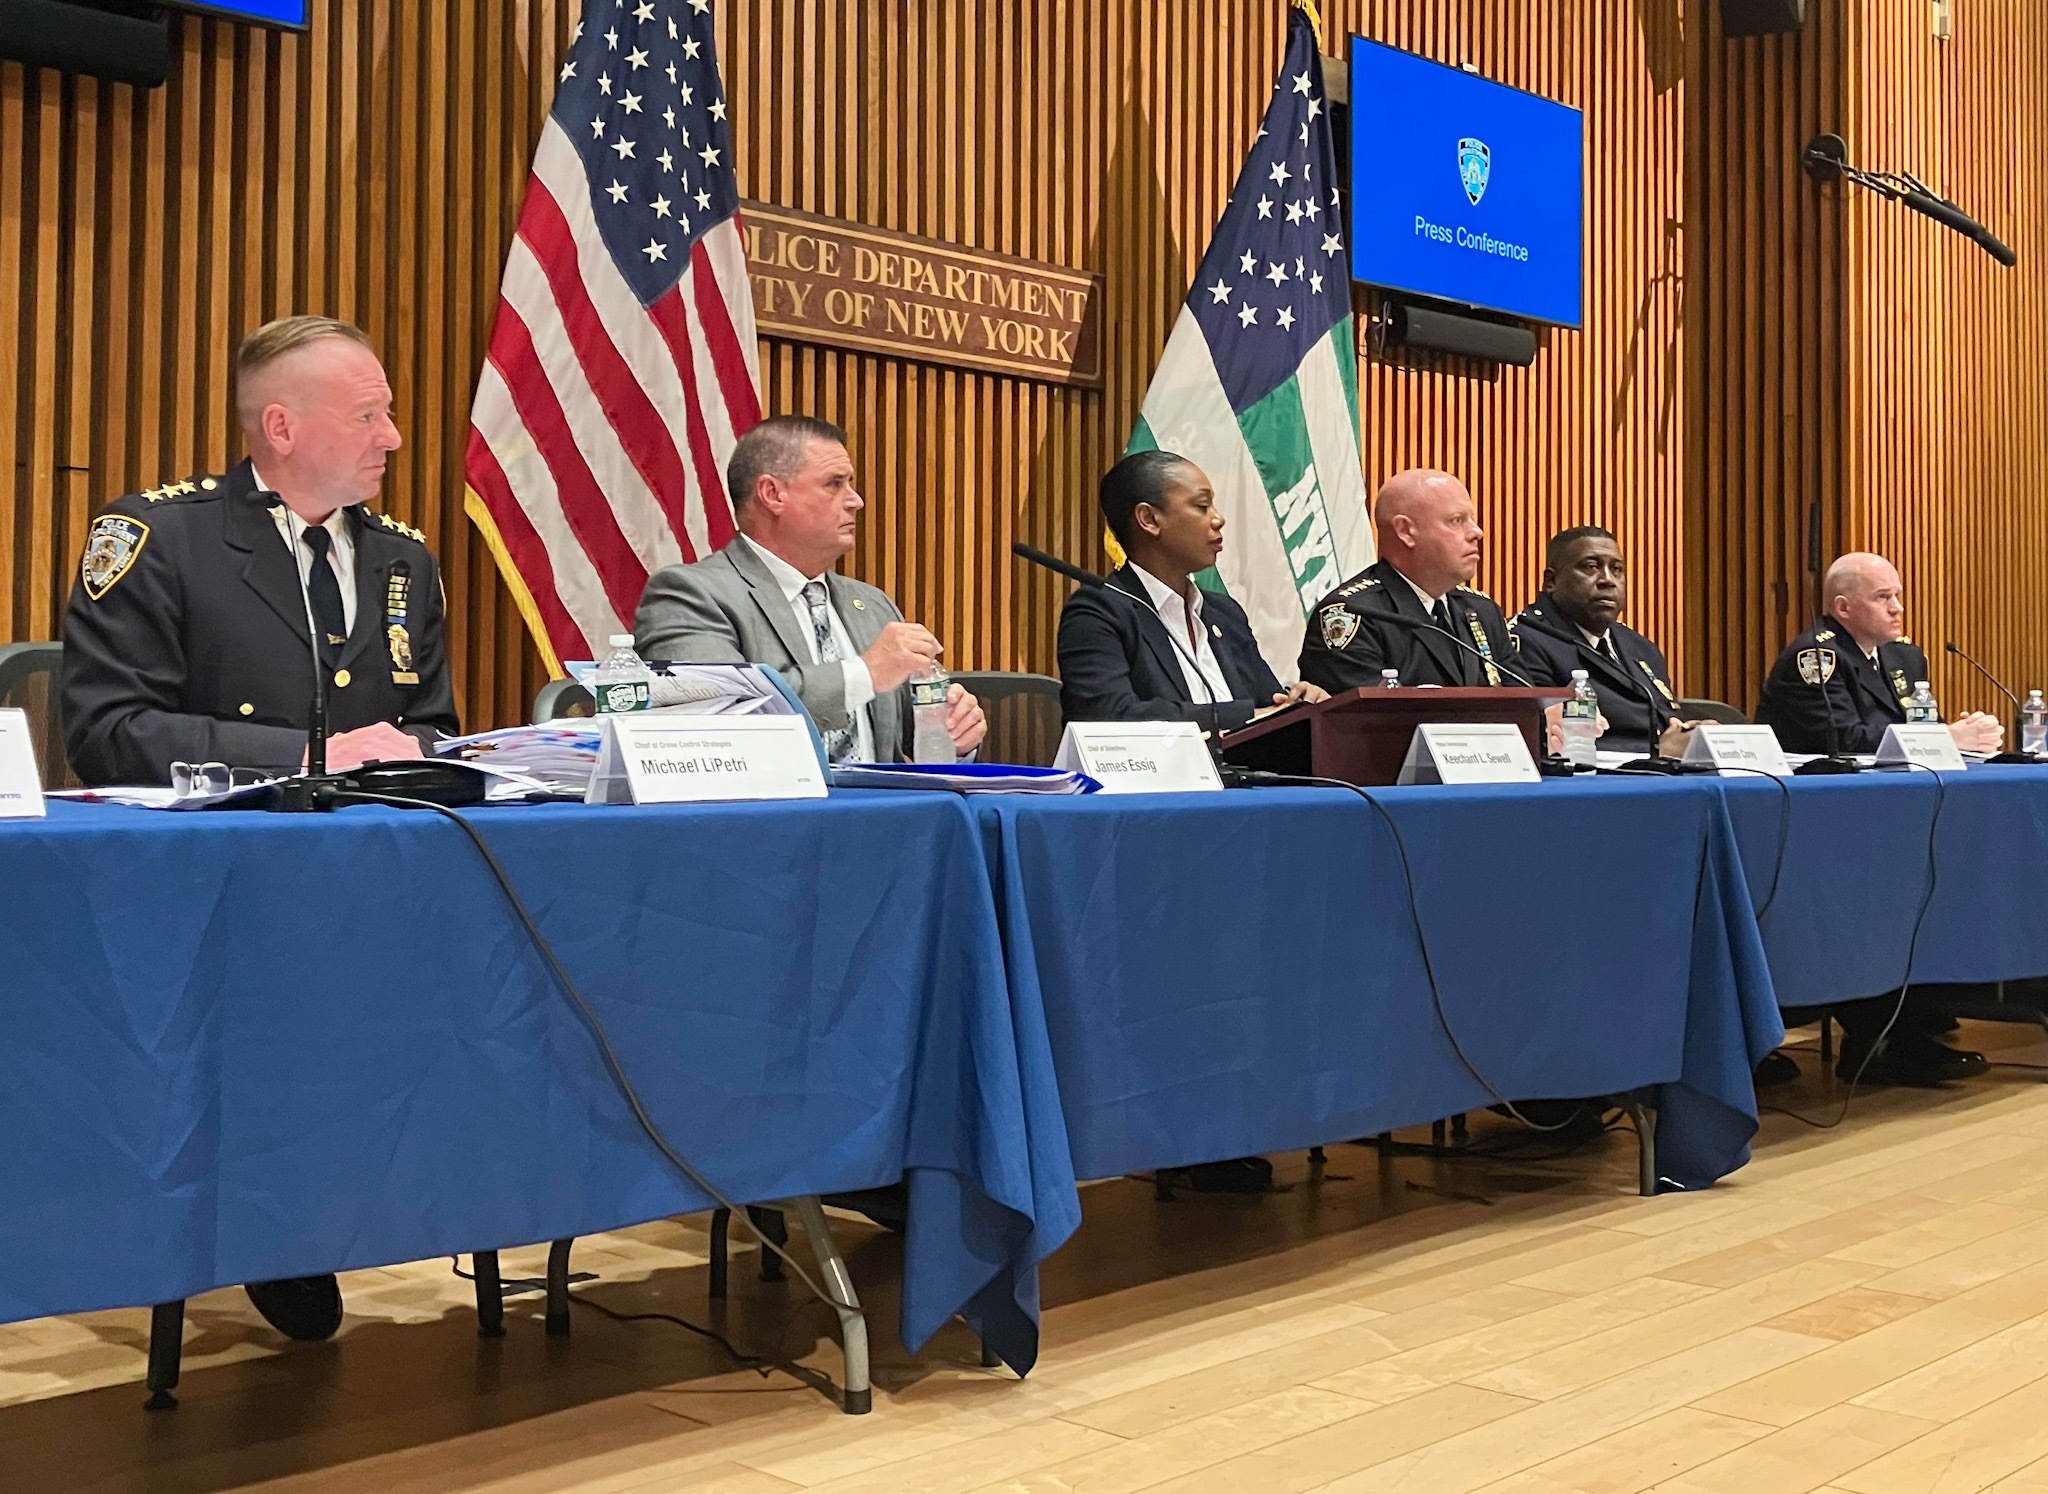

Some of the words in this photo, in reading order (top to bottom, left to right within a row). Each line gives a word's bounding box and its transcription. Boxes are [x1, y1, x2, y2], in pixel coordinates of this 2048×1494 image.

[1415, 216, 1453, 243] Press
[1457, 226, 1528, 261] Conference
[743, 226, 841, 277] LICE
[853, 246, 1087, 323] DEPARTMENT
[751, 273, 812, 318] TY
[825, 289, 874, 328] OF
[885, 298, 969, 345] NEW
[980, 315, 1073, 363] YORK
[640, 758, 700, 775] Michael
[701, 756, 748, 773] LiPetri
[1095, 759, 1128, 773] James
[1128, 757, 1158, 774] Essig
[1486, 752, 1512, 764] Sewell
